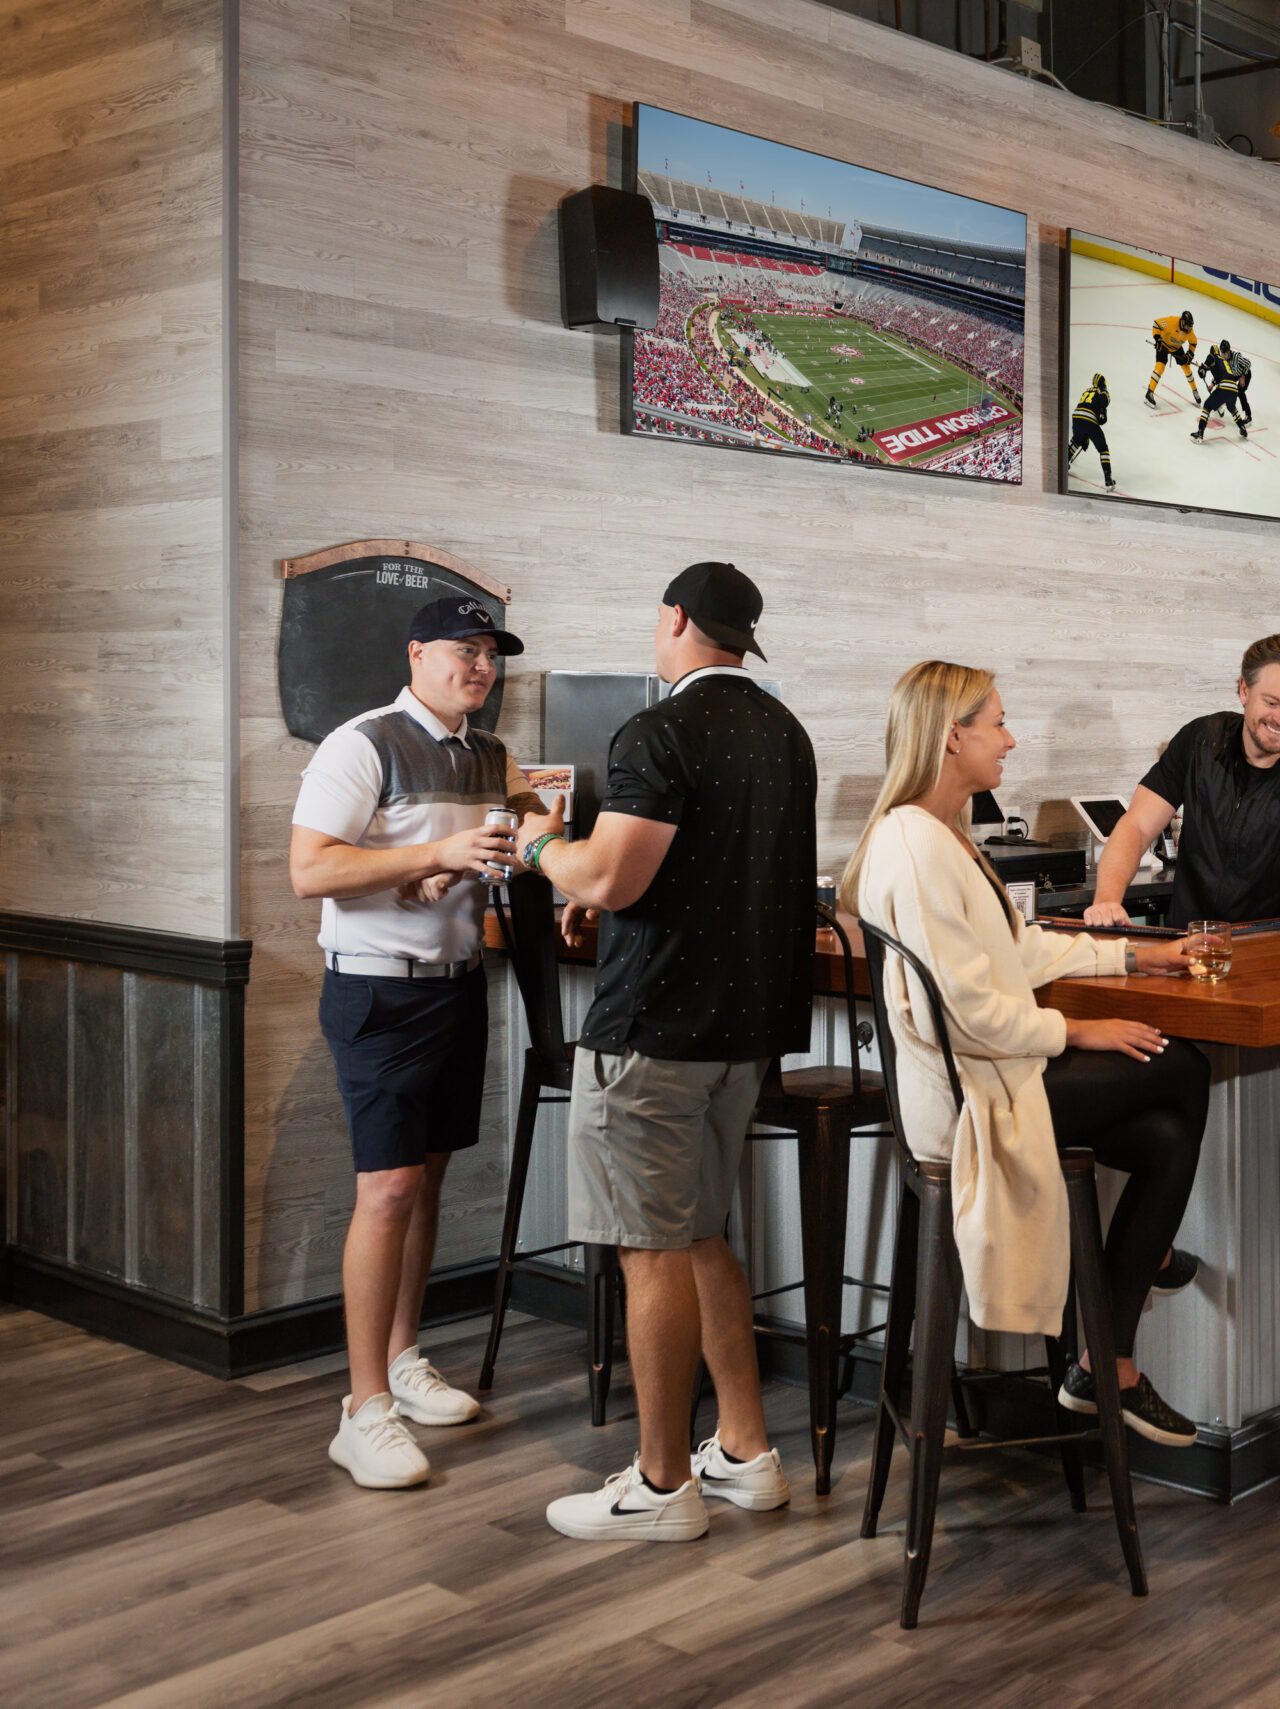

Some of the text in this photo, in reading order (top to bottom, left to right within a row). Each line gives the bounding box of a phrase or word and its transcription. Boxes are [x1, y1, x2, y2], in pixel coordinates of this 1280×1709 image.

[880, 426, 942, 455] TIDE
[382, 562, 425, 575] FOR THE
[376, 571, 399, 586] LOVE
[405, 573, 429, 589] BEER
